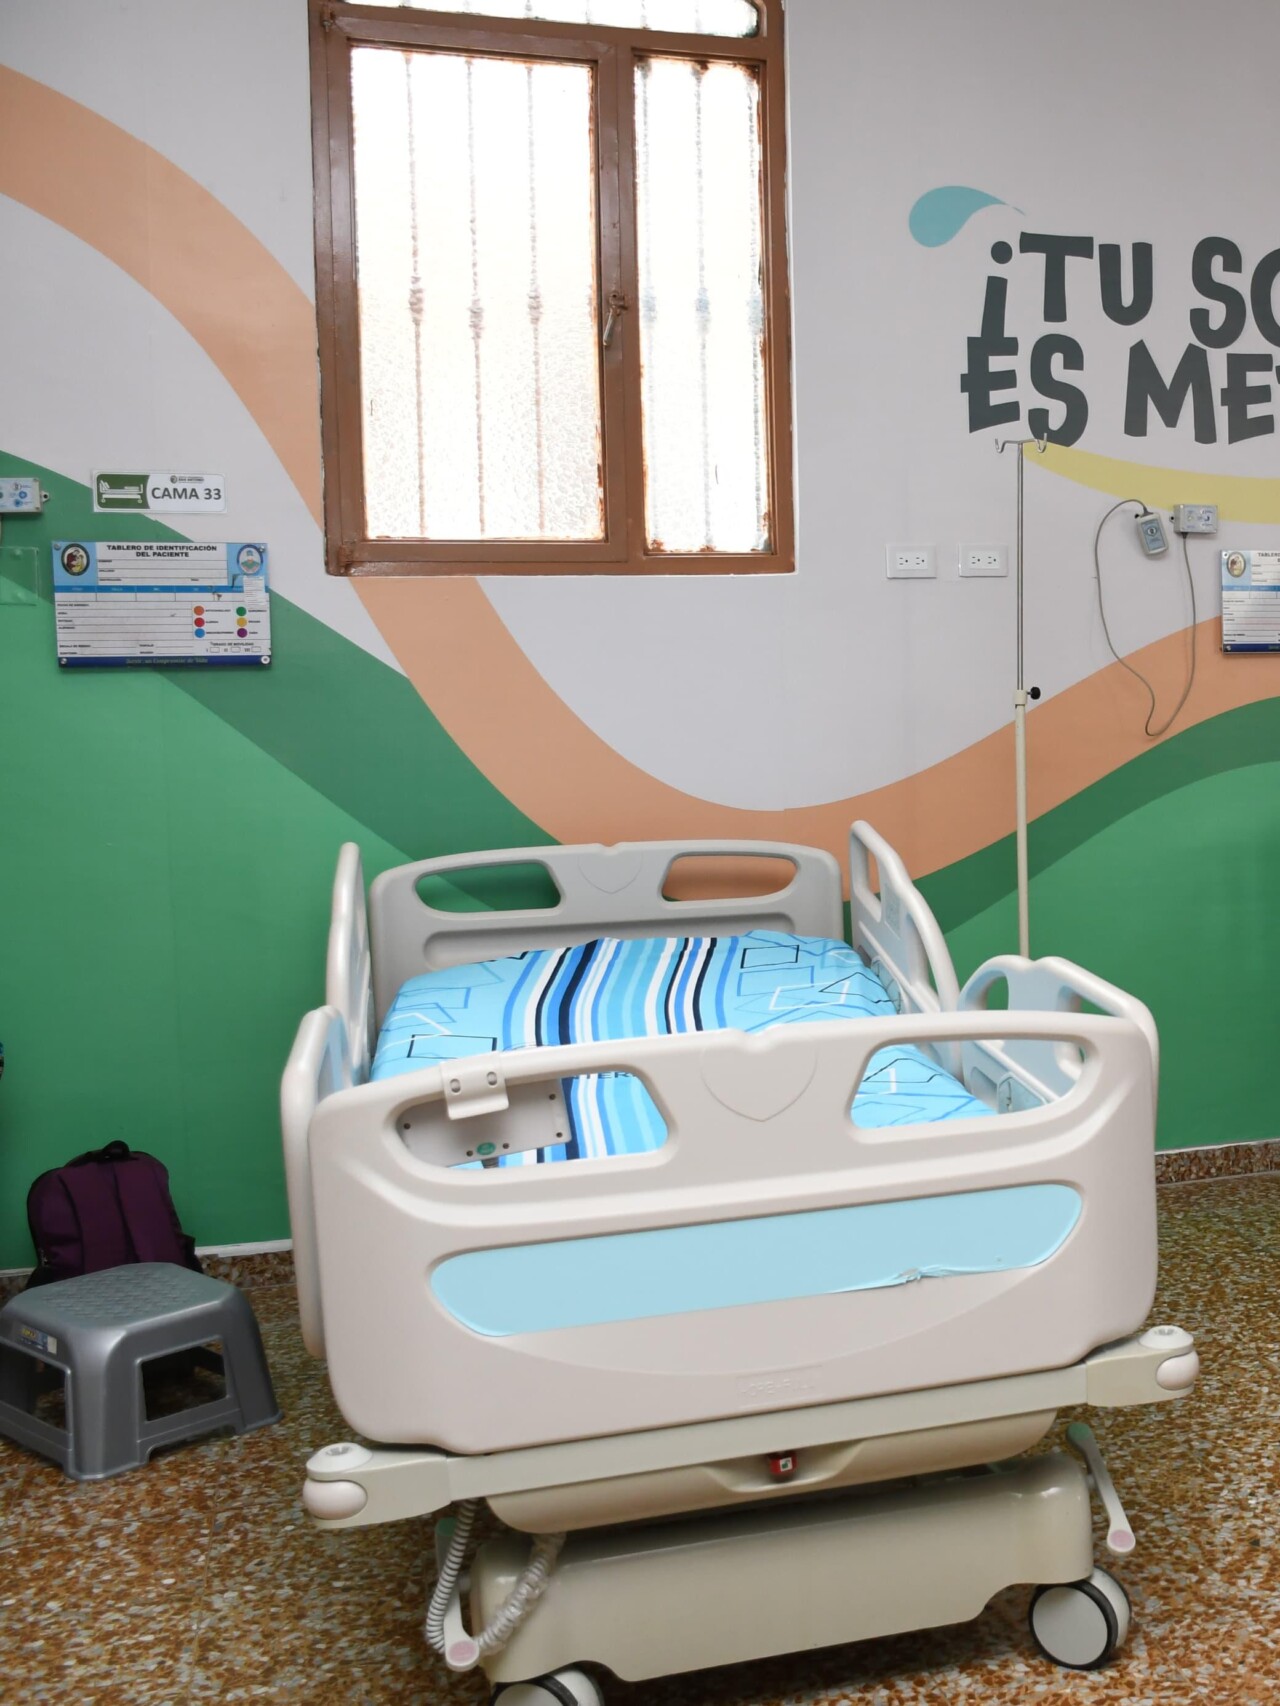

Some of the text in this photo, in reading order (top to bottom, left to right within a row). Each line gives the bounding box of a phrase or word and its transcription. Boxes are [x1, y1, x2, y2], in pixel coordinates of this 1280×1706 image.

[960, 333, 1089, 449] ES
[151, 487, 222, 500] CAMA 33
